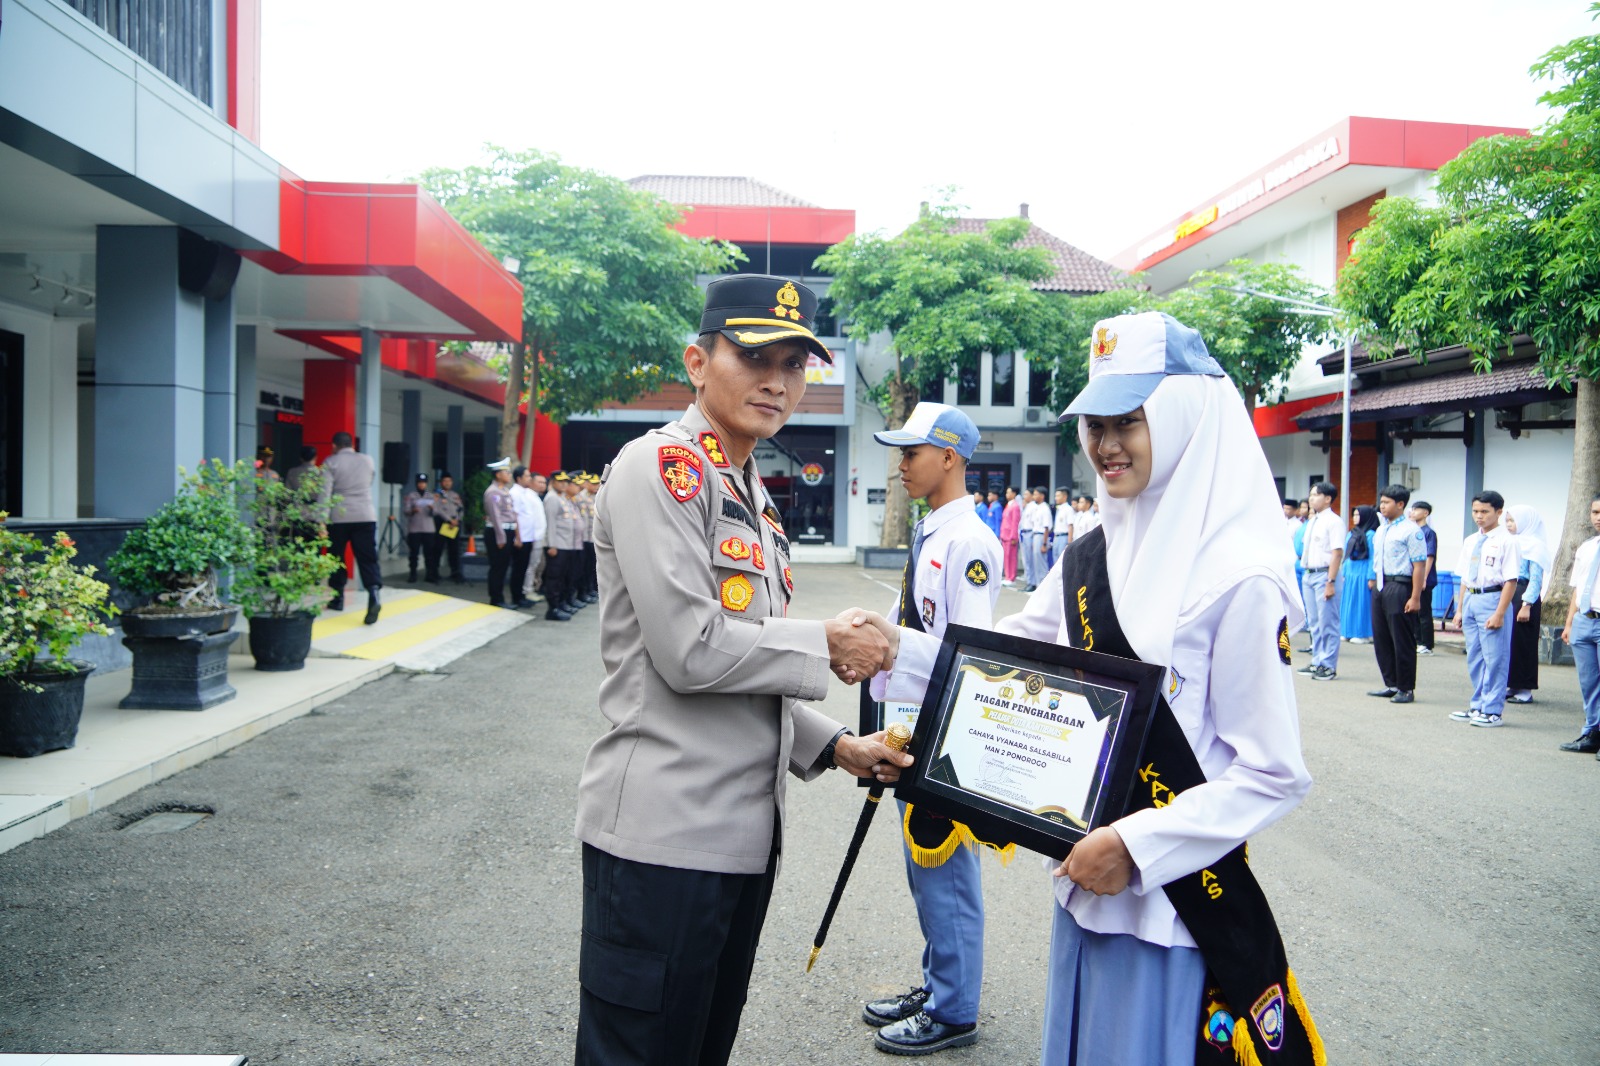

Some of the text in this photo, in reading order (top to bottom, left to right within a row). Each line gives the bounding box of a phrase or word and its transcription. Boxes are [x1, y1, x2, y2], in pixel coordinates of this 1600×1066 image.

[662, 447, 700, 466] PROPAM
[974, 693, 1085, 729] PIAGAM PENGHARGAAN
[996, 723, 1021, 735] Diberikan
[1022, 731, 1042, 742] kepada
[968, 728, 1072, 764] CAHAYA VYANARA SALSABILLA
[984, 744, 1000, 754] MAN
[1006, 751, 1047, 768] PONOROGO
[1253, 988, 1277, 1016] BINMAS
